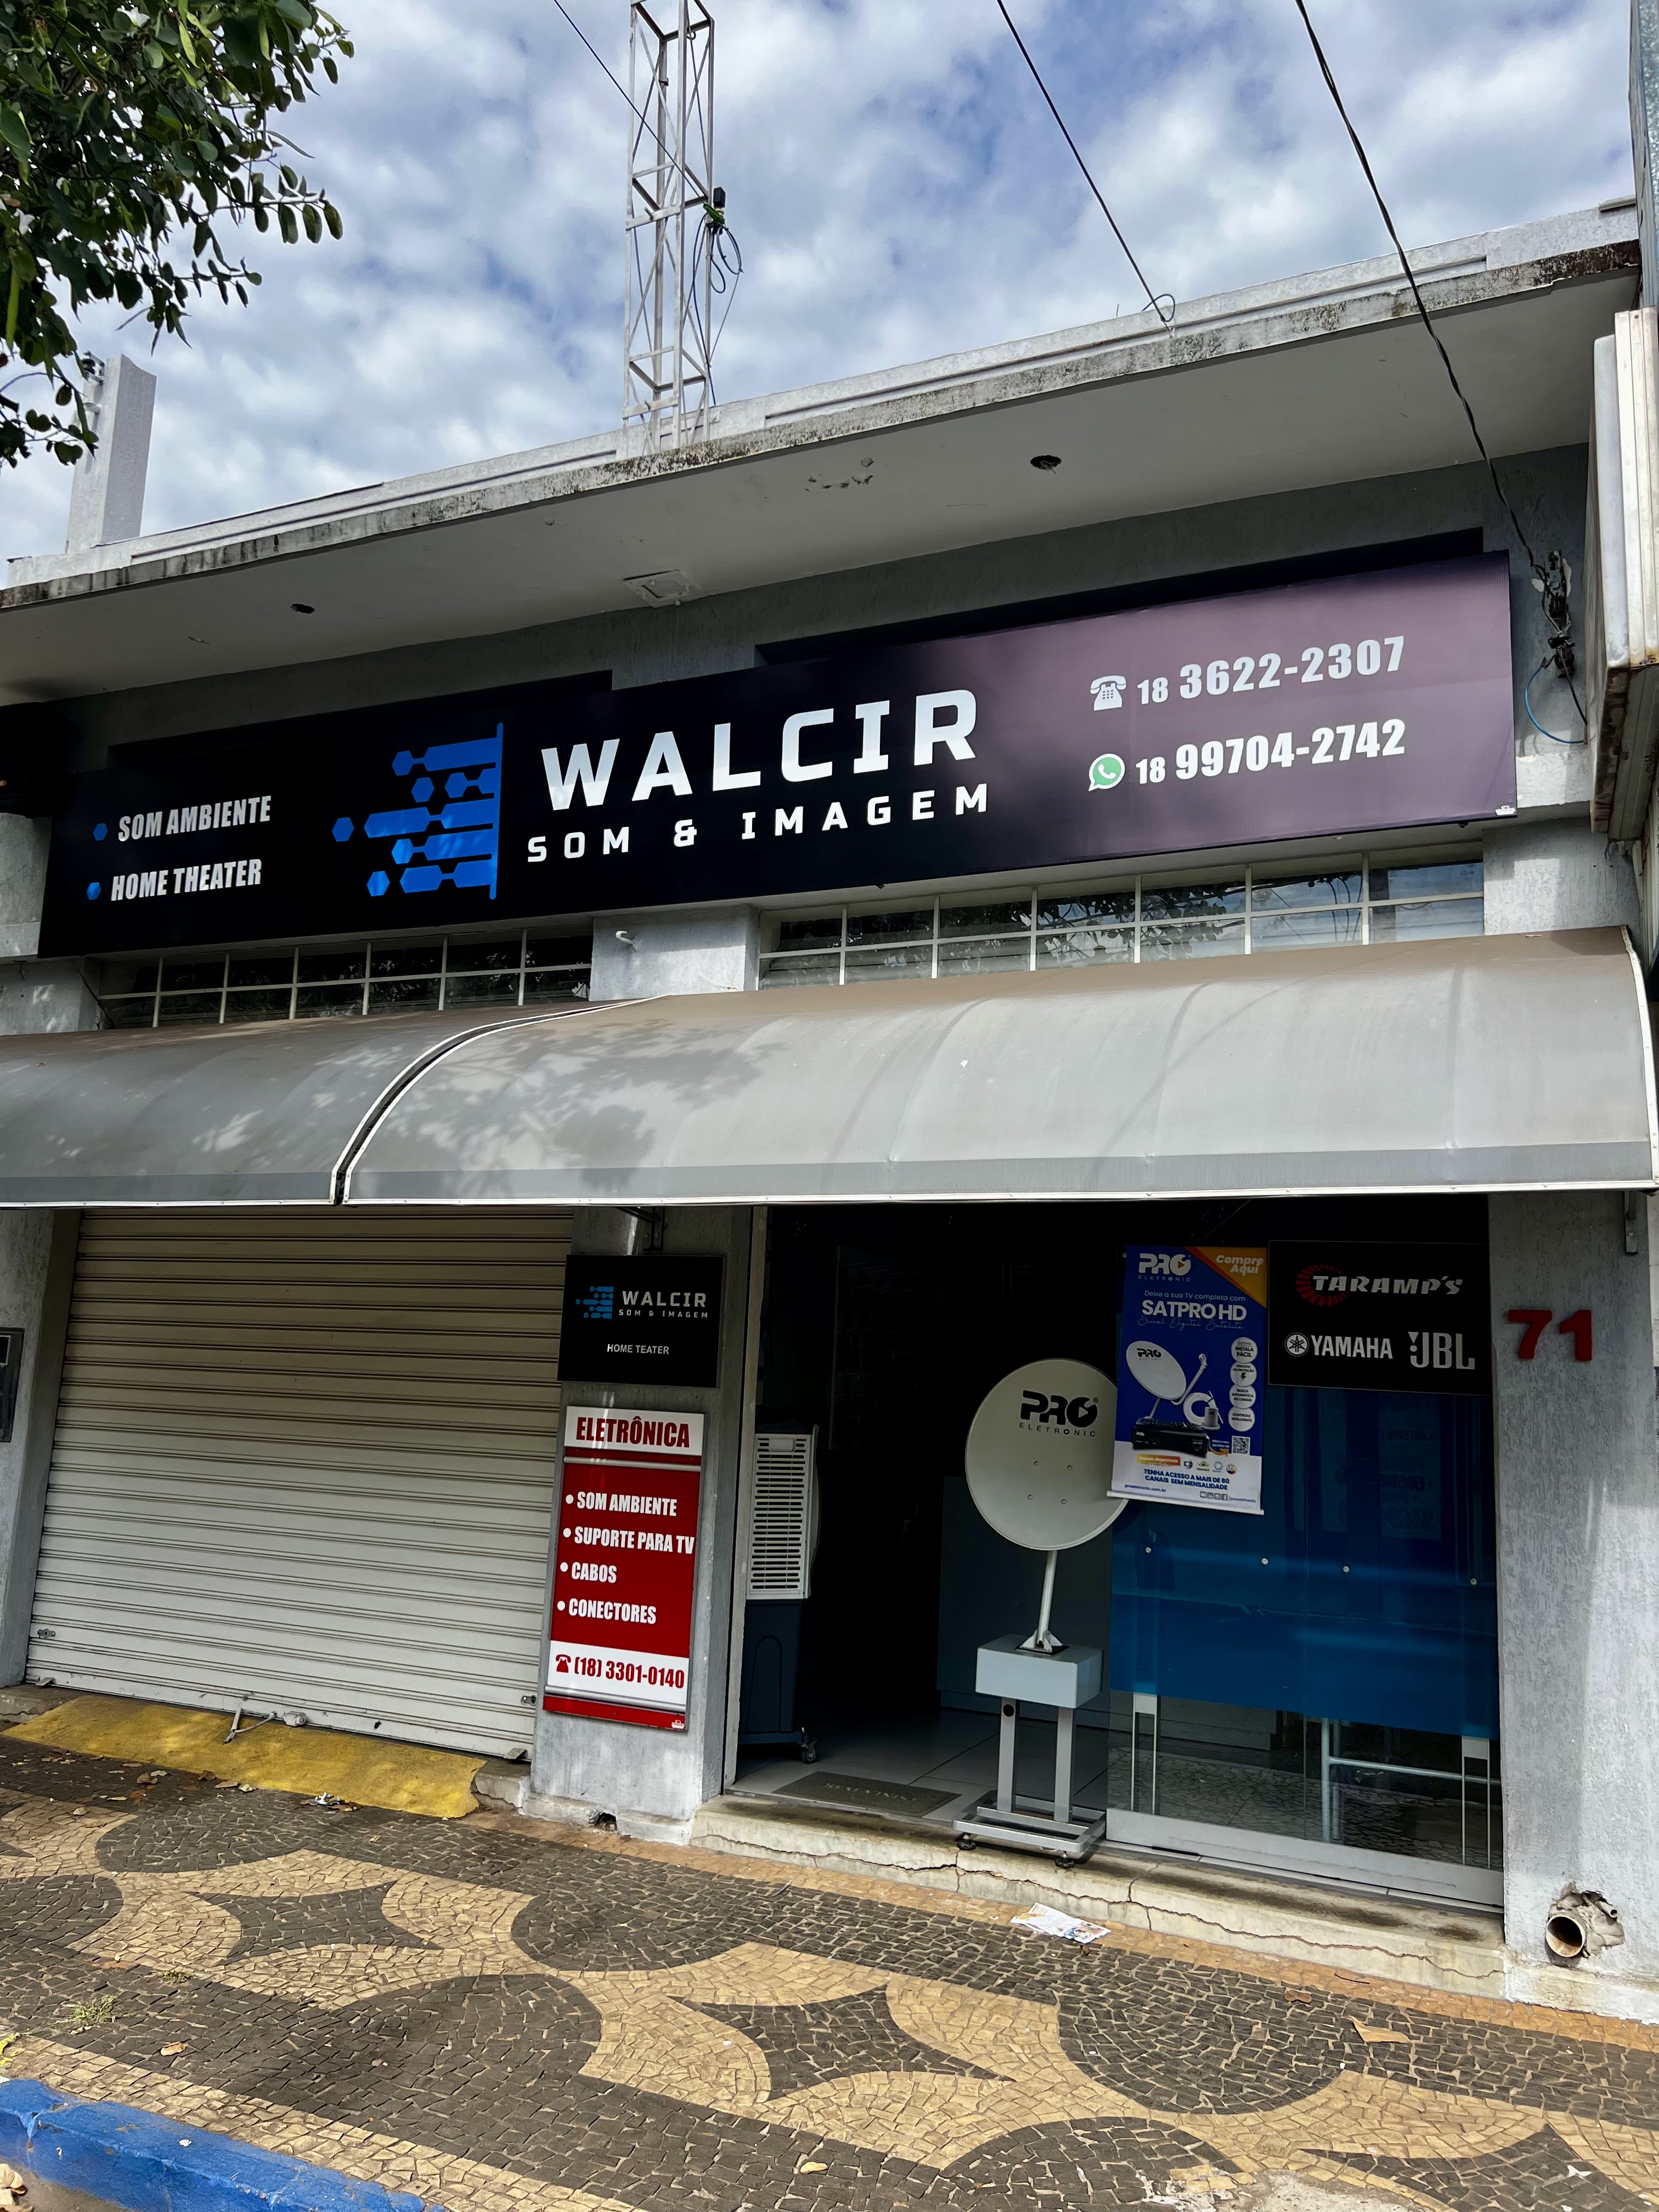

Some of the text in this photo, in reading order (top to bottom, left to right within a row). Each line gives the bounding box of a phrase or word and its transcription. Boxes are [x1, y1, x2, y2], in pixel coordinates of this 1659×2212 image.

[1137, 635, 1404, 704] 18 3622-2307
[541, 689, 977, 811] WALCIR
[1136, 719, 1406, 784] 18 99704-2742
[117, 795, 272, 842] SOM AMBIENTE
[527, 783, 988, 862] SOM & IMAGEM
[111, 859, 262, 901] HOME THEATER
[1138, 1253, 1192, 1276] PRO
[1216, 1255, 1264, 1265] Compre
[1230, 1264, 1259, 1276] Aqui
[1195, 1293, 1228, 1301] completa
[1313, 1276, 1463, 1295] TARAMP'S
[622, 1290, 707, 1307] WALCIR
[662, 1310, 708, 1318] IMAGEM
[1311, 1335, 1393, 1359] YAMAHA
[1508, 1310, 1592, 1361] 71
[607, 1344, 669, 1355] HOME TEATER
[1408, 1331, 1476, 1370] JBL
[1020, 1390, 1098, 1427] PRO
[576, 1417, 690, 1448] ELETRÔNICA
[1019, 1422, 1096, 1437] ELETRONIC
[1184, 1480, 1228, 1490] MENSALIDADE
[577, 1491, 678, 1516] SOM AMBIENTE
[574, 1526, 695, 1555] SUPORTE PARA TV
[571, 1562, 617, 1583] CABOS
[568, 1598, 656, 1624] CONECTORES
[574, 1656, 685, 1689] (18) 3301-0140
